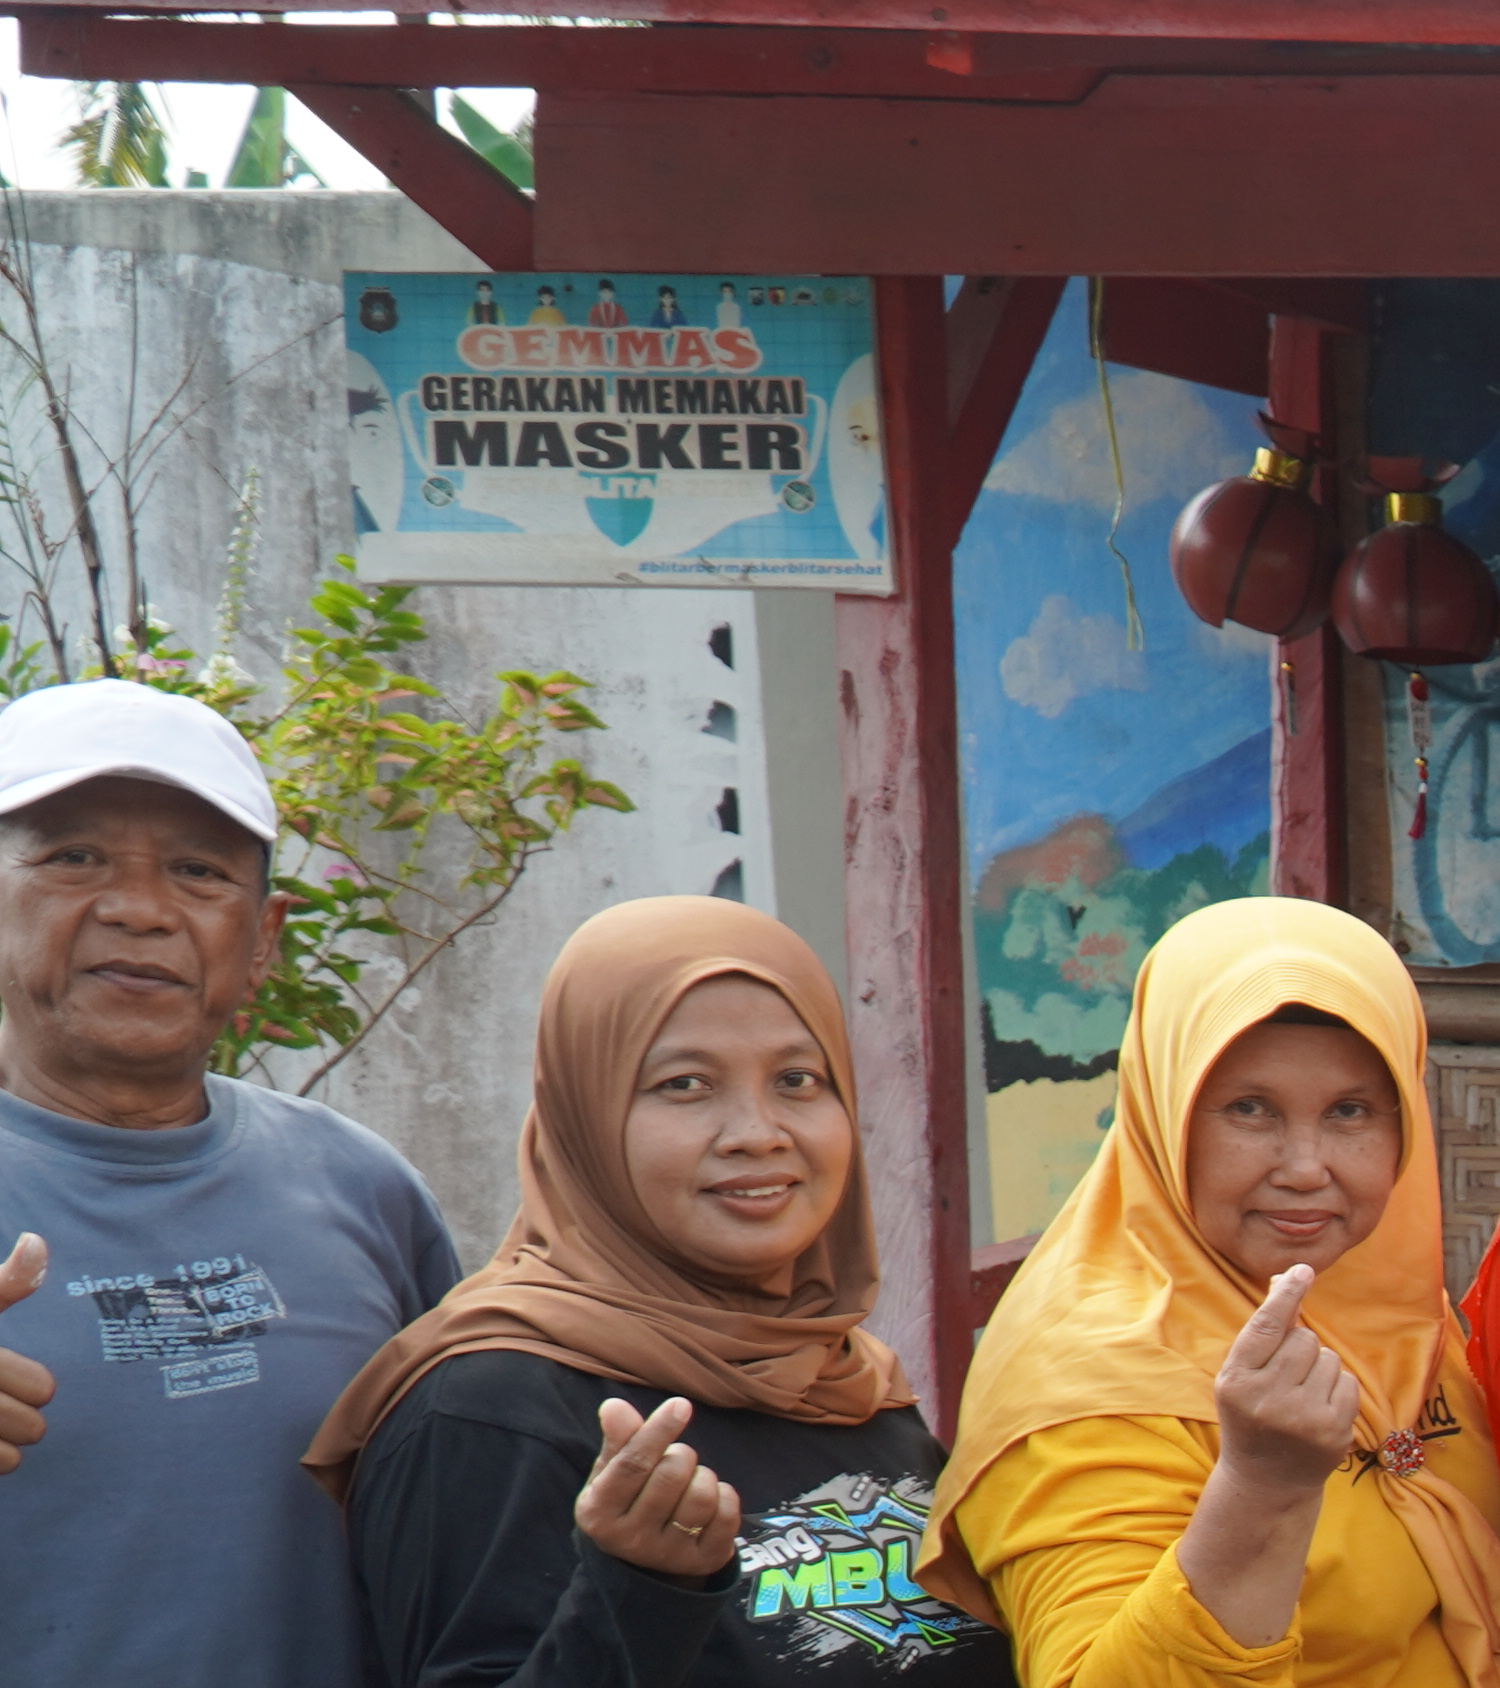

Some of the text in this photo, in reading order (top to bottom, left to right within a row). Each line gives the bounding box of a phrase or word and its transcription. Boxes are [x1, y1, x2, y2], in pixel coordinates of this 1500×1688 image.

[460, 327, 759, 369] GEMMAS
[422, 375, 802, 415] GERAKAN MEMAKAI
[434, 420, 803, 470] MASKER
[66, 1253, 248, 1297] since 1991
[205, 1280, 265, 1304] BORN
[215, 1302, 274, 1326] ROCK
[224, 1295, 256, 1311] TO
